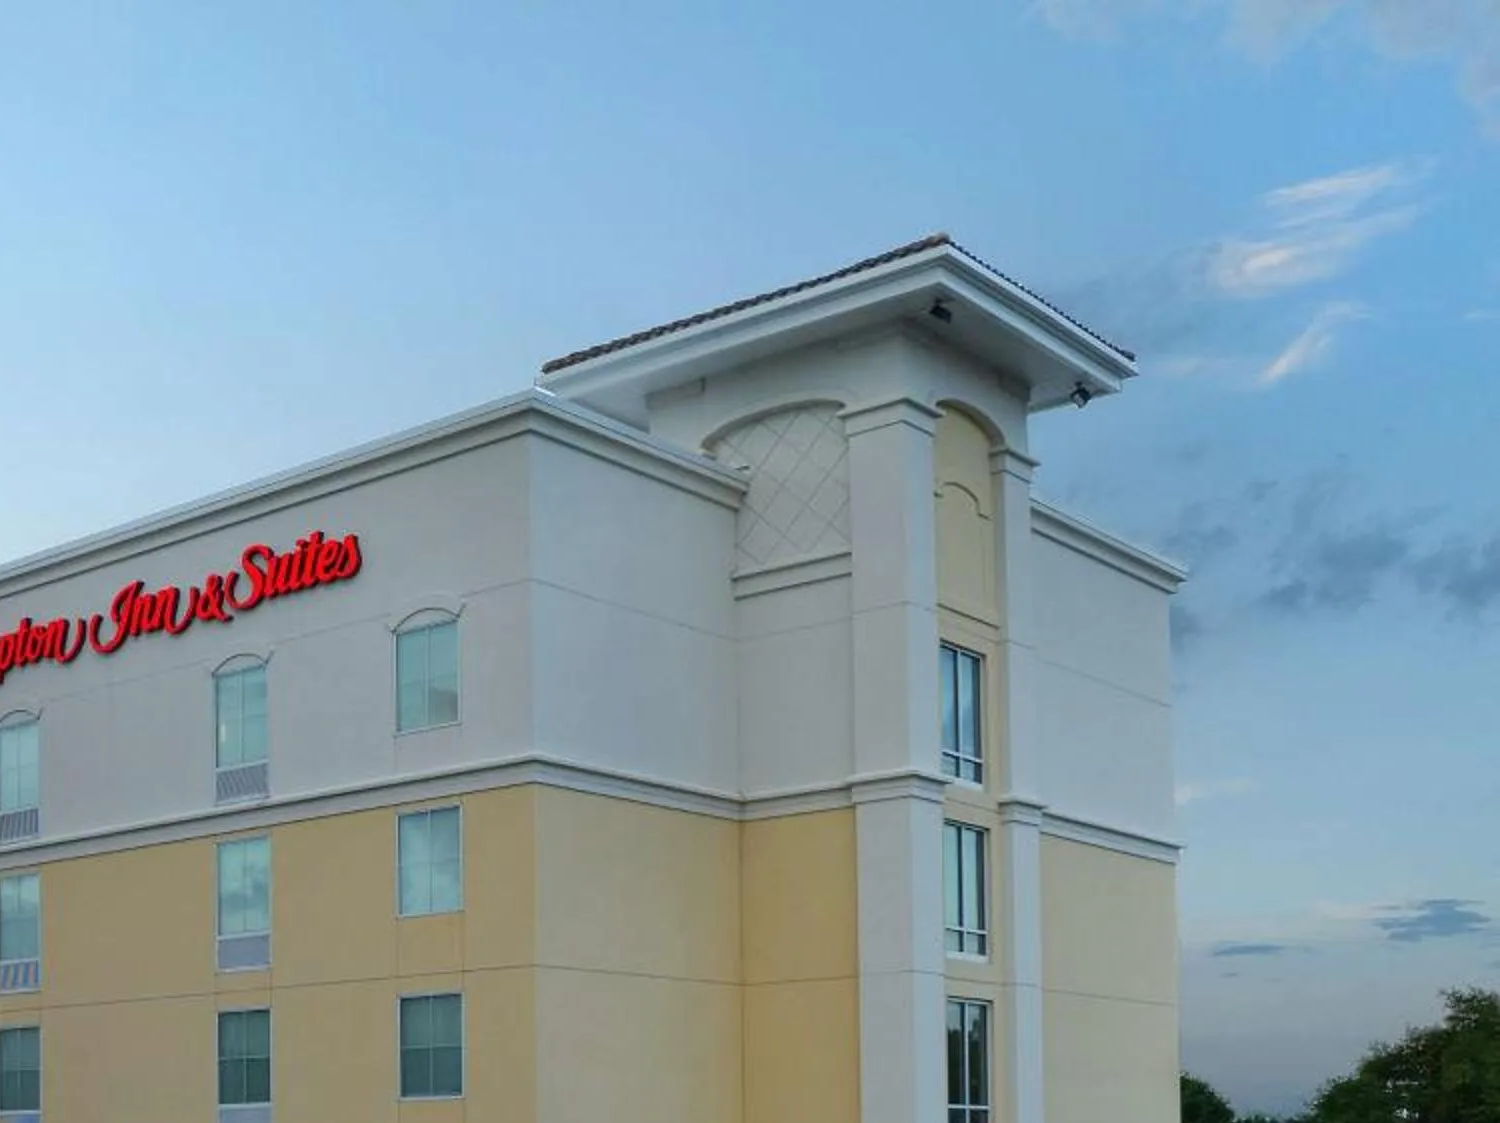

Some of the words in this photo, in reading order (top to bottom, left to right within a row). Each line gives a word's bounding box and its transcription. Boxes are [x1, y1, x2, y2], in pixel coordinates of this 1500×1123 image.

[89, 579, 197, 653] Inn
[196, 574, 233, 622] &
[225, 530, 362, 610] Suites
